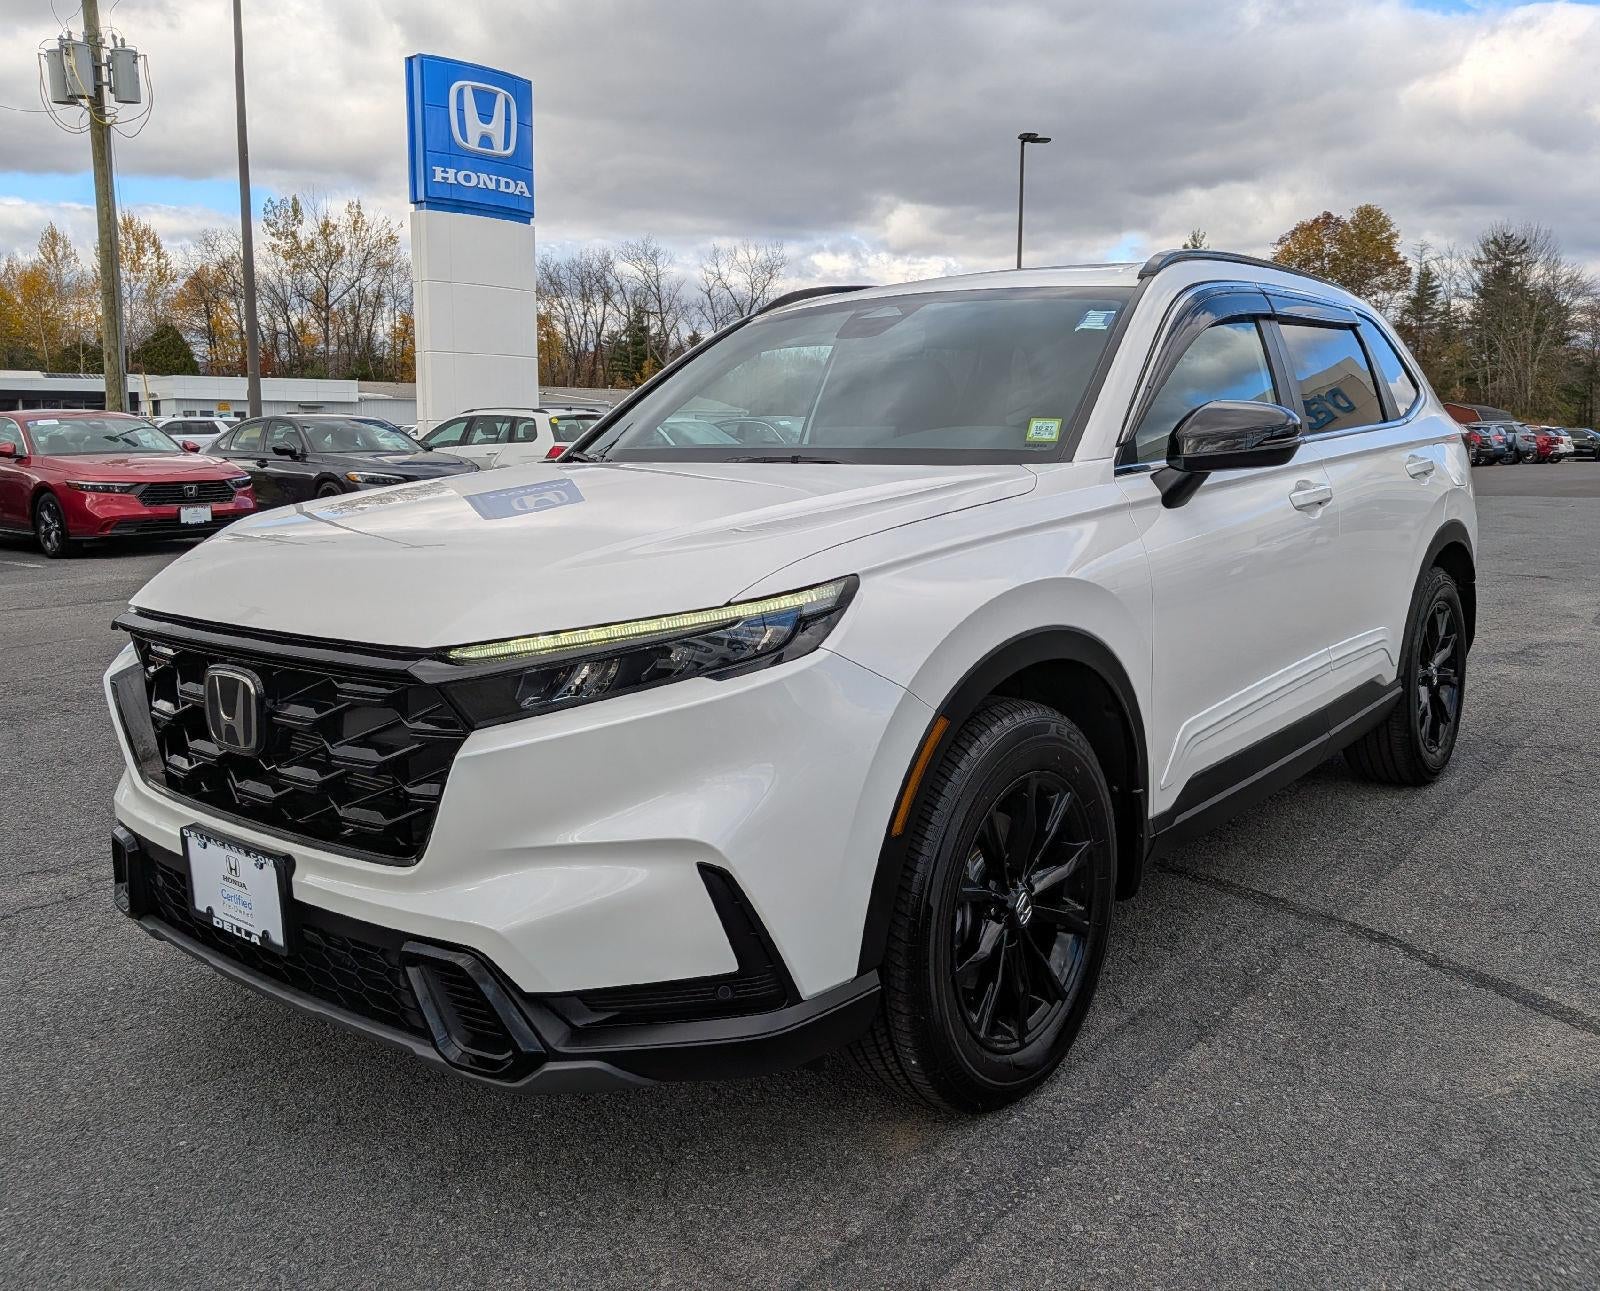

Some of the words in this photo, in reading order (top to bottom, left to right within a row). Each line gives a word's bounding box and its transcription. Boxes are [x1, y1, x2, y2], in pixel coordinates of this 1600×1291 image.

[432, 166, 532, 198] HONDA
[222, 874, 248, 890] HONDA
[221, 888, 253, 910] Certified
[212, 916, 261, 945] DELLA
